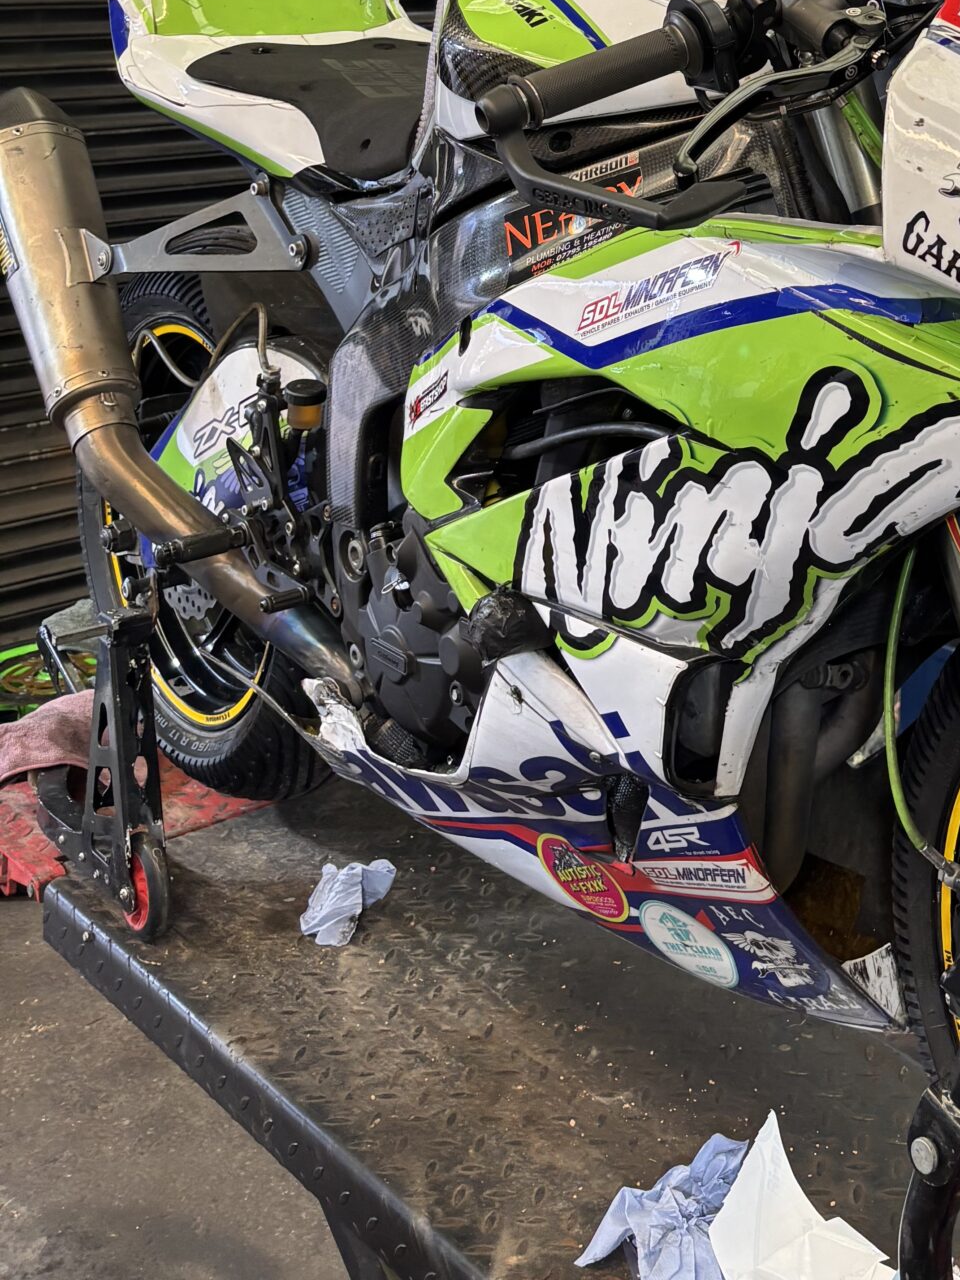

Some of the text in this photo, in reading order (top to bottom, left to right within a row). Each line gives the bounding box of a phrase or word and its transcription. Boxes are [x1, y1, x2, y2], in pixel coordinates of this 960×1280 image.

[526, 239, 571, 265] PLUMBING
[583, 223, 622, 243] HEATING
[531, 258, 555, 272] MOB:
[577, 291, 622, 331] SDL
[580, 323, 601, 338] VEHICLE
[601, 316, 620, 329] SPARES
[624, 304, 651, 318] EXHAUSTS
[655, 293, 677, 306] GARAGE
[557, 864, 601, 883] AUTISTIC
[691, 945, 722, 957] CLEAN
